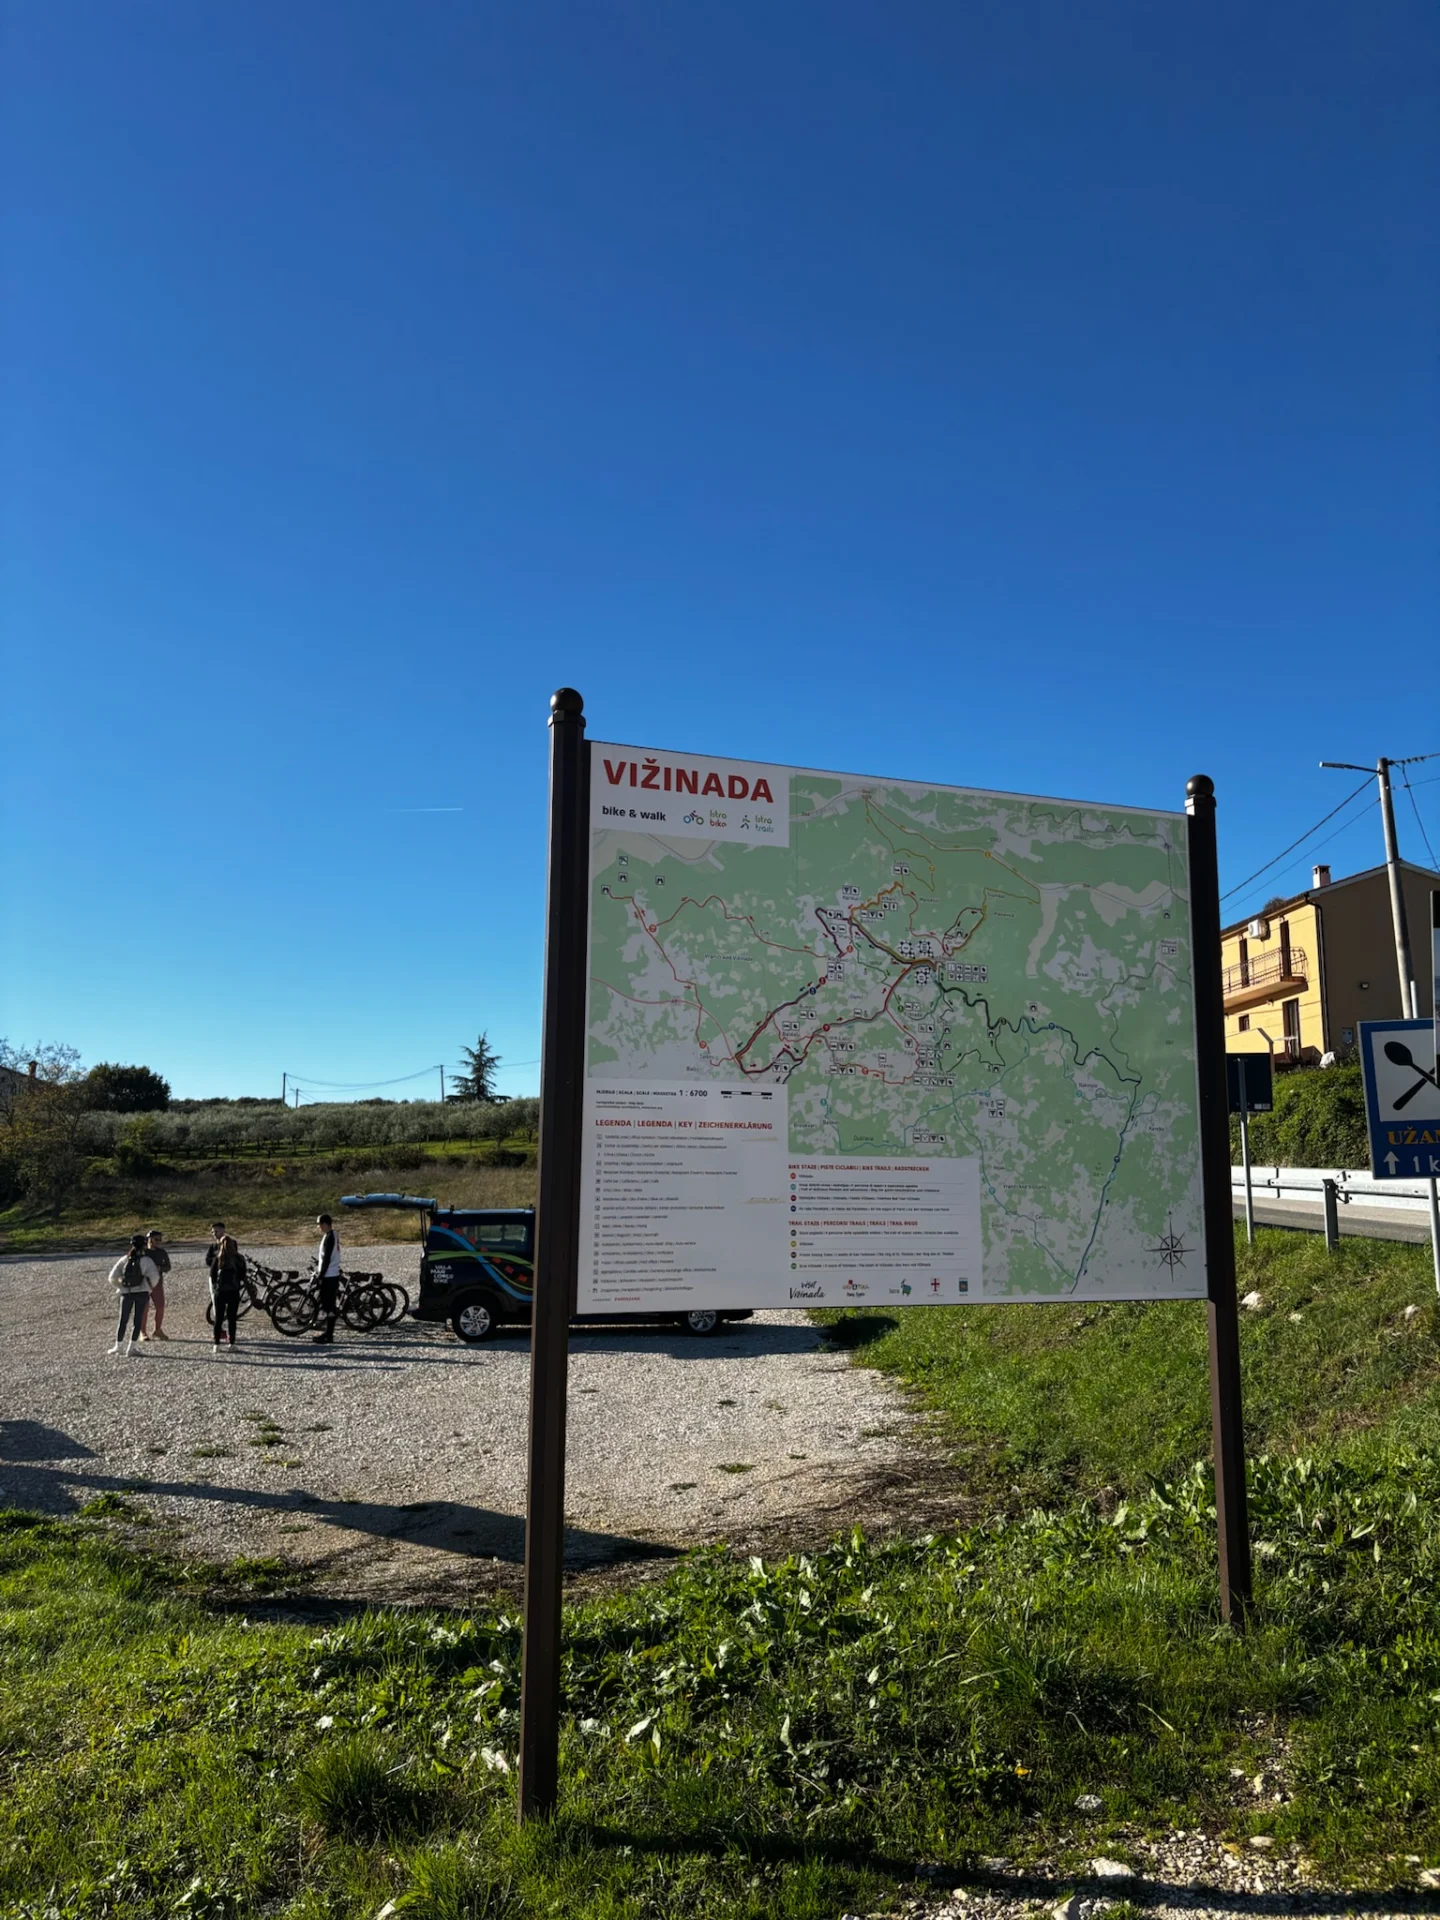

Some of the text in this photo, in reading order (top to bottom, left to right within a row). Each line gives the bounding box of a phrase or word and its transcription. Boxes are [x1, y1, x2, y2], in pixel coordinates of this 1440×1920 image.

[603, 757, 774, 803] VIŽINADA
[602, 805, 666, 821] bike & walk
[689, 1090, 708, 1098] 6700
[595, 1119, 632, 1127] LEGENDA
[637, 1120, 673, 1128] LEGENDA
[698, 1121, 773, 1130] ZEICHENERKLÄRUNG
[1413, 1155, 1420, 1173] 1
